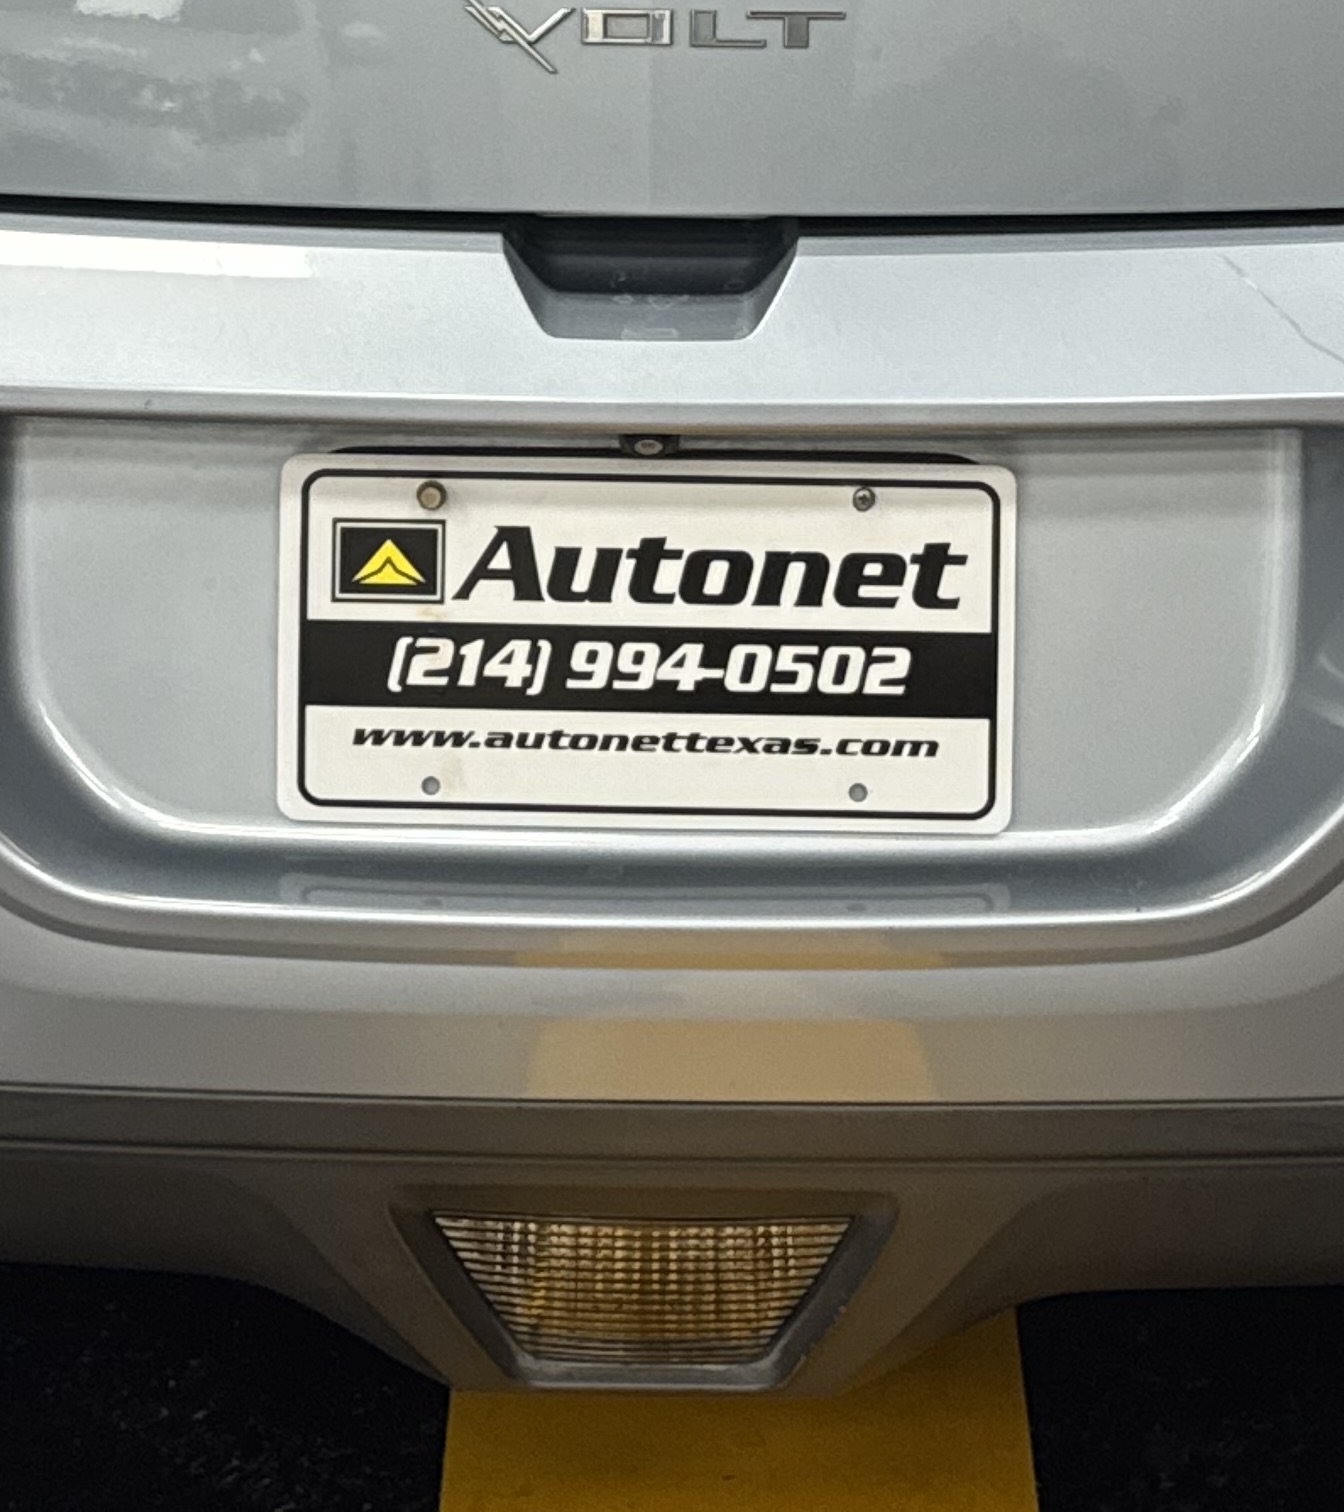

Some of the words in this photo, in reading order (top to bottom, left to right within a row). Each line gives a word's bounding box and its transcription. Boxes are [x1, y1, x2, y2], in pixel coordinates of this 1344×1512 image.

[451, 524, 969, 610] Autonet
[386, 636, 552, 697] (214)
[565, 638, 913, 698] 994-0502
[350, 725, 942, 760] www.autonettexas.com
